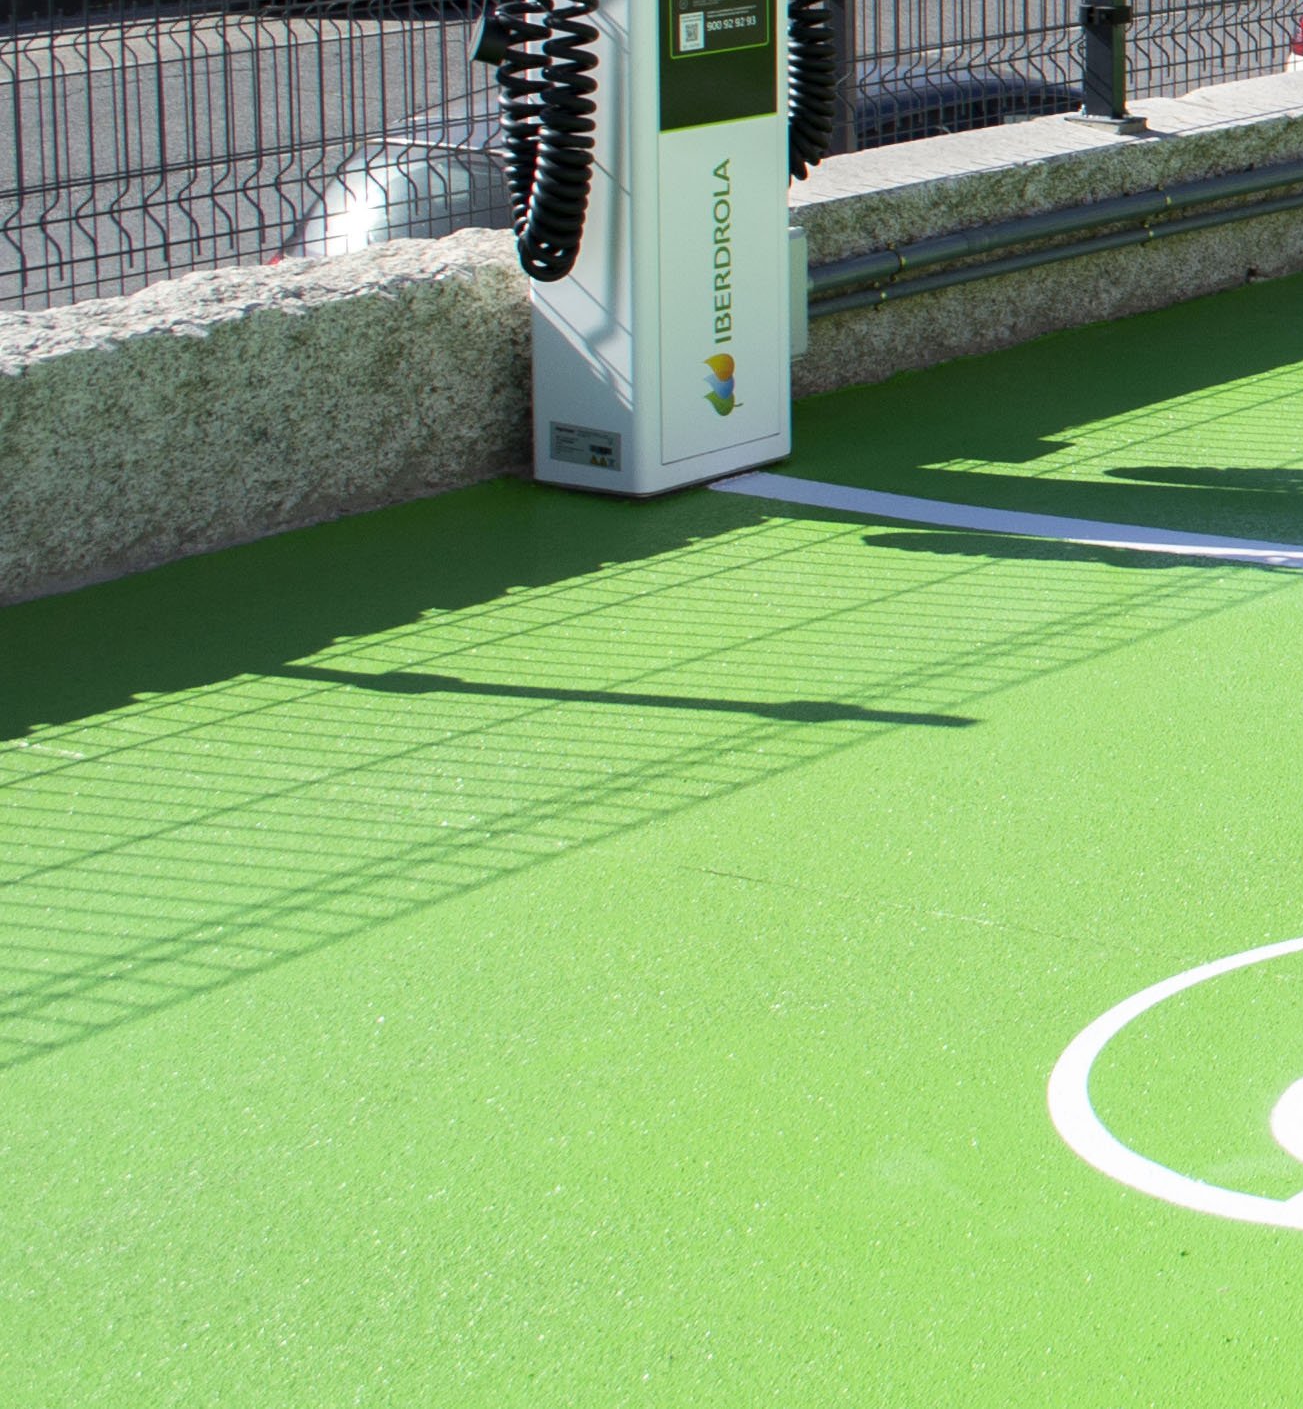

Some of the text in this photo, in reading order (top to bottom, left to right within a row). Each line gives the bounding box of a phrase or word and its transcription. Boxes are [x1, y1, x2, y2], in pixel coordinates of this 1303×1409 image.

[706, 14, 757, 32] 900 92 92 93
[713, 157, 732, 343] IBERDROLA
